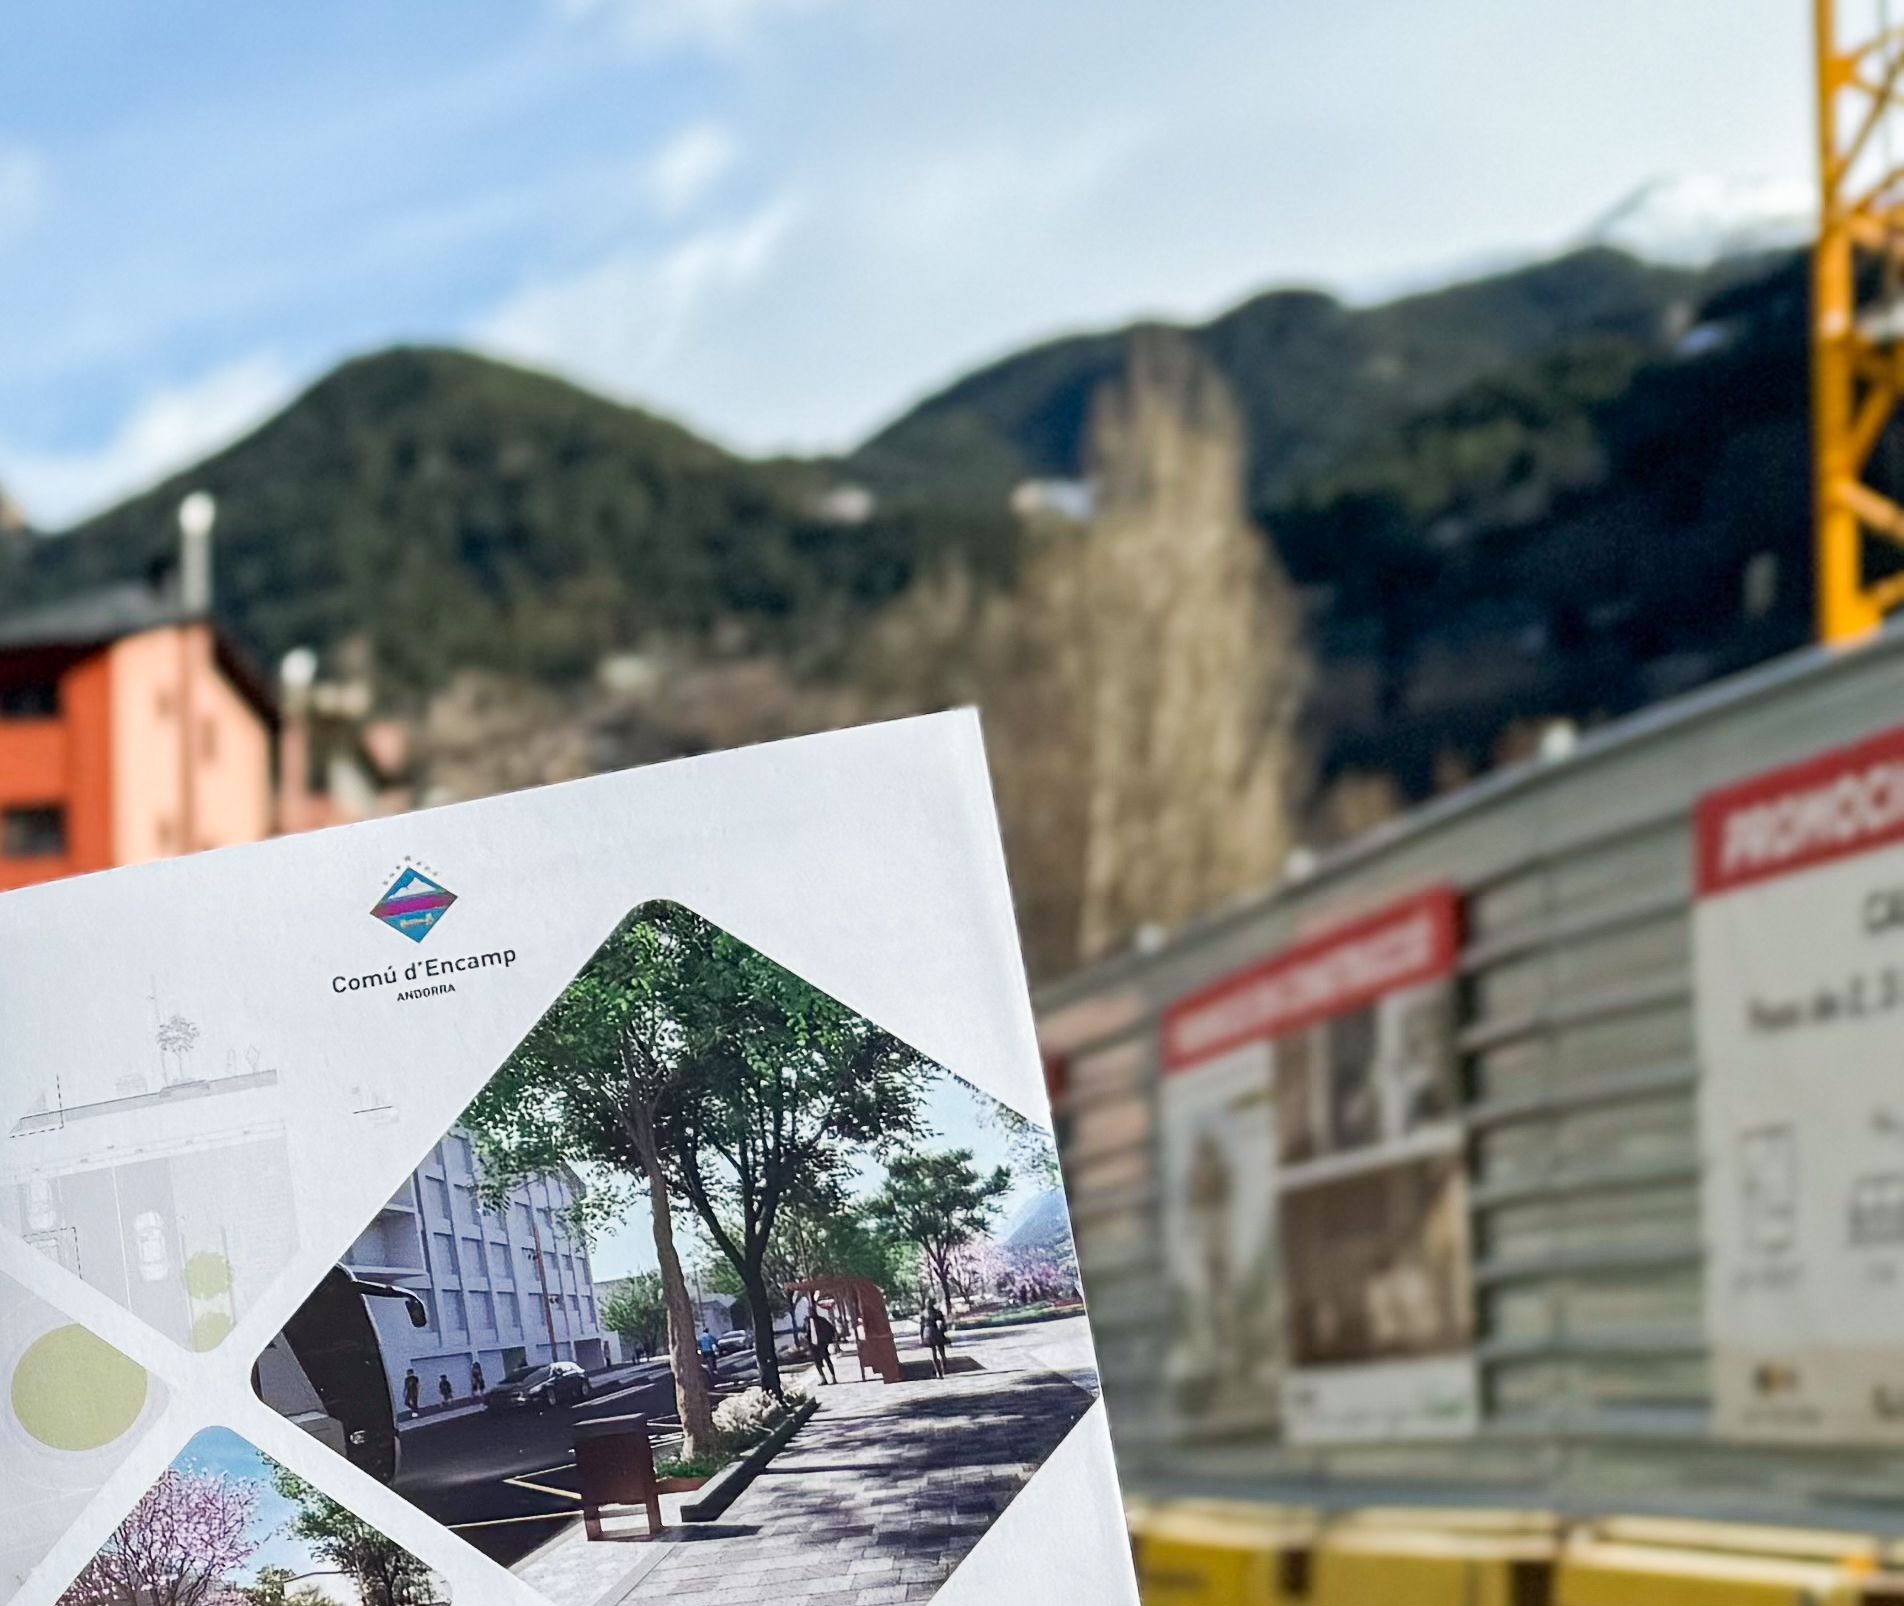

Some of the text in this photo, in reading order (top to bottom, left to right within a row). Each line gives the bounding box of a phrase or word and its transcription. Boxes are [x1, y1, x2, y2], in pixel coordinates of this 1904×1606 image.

[332, 948, 516, 993] Comú d'Encamp
[396, 983, 456, 1002] ANDORRA
